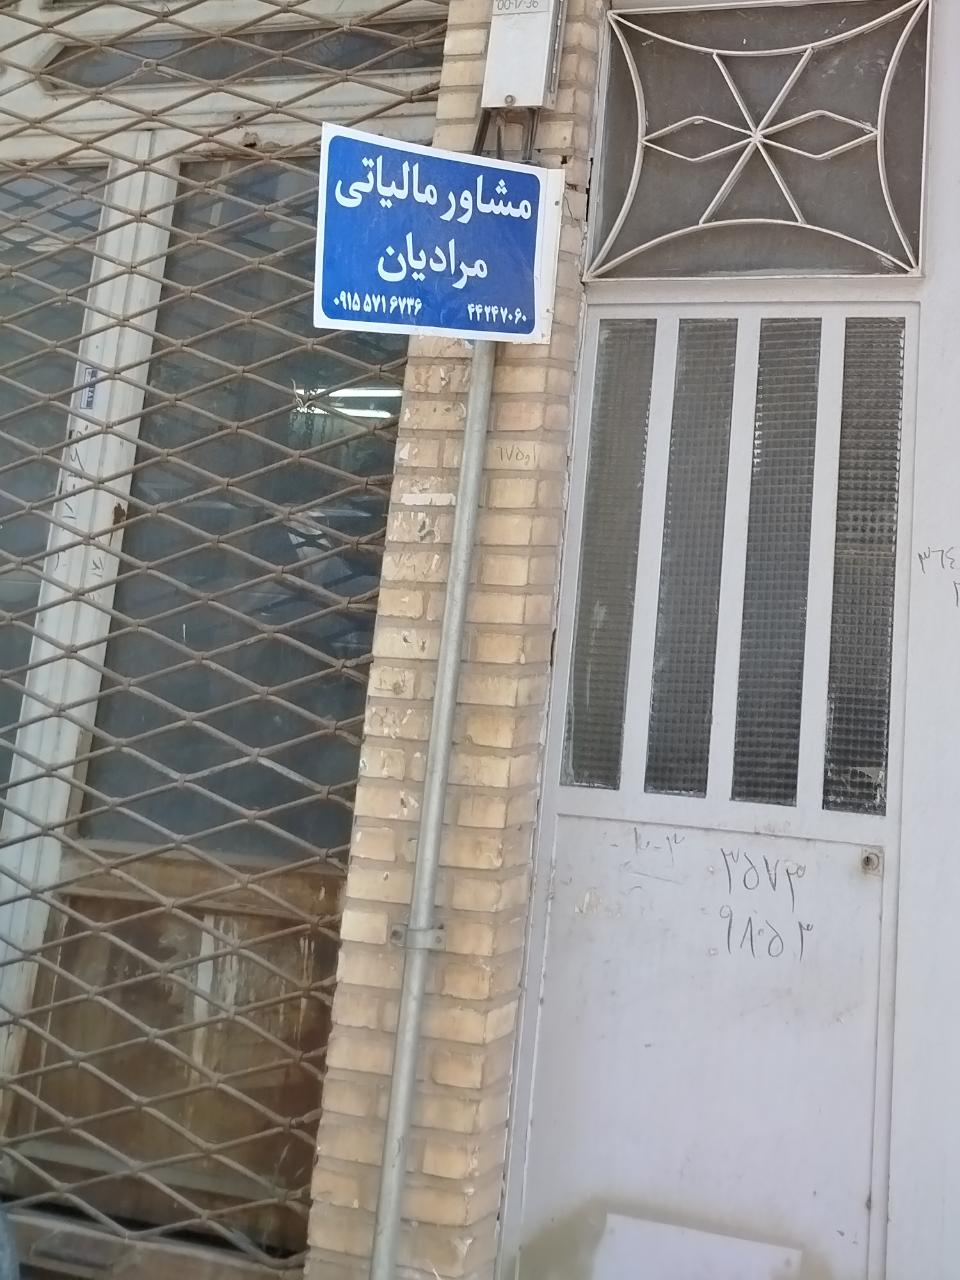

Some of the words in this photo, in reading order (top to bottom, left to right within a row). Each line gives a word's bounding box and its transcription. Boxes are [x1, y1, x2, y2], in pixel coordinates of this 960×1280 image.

[334, 155, 438, 209] مالیاتی
[439, 174, 532, 224] مشاور
[377, 231, 489, 290] مرادیان
